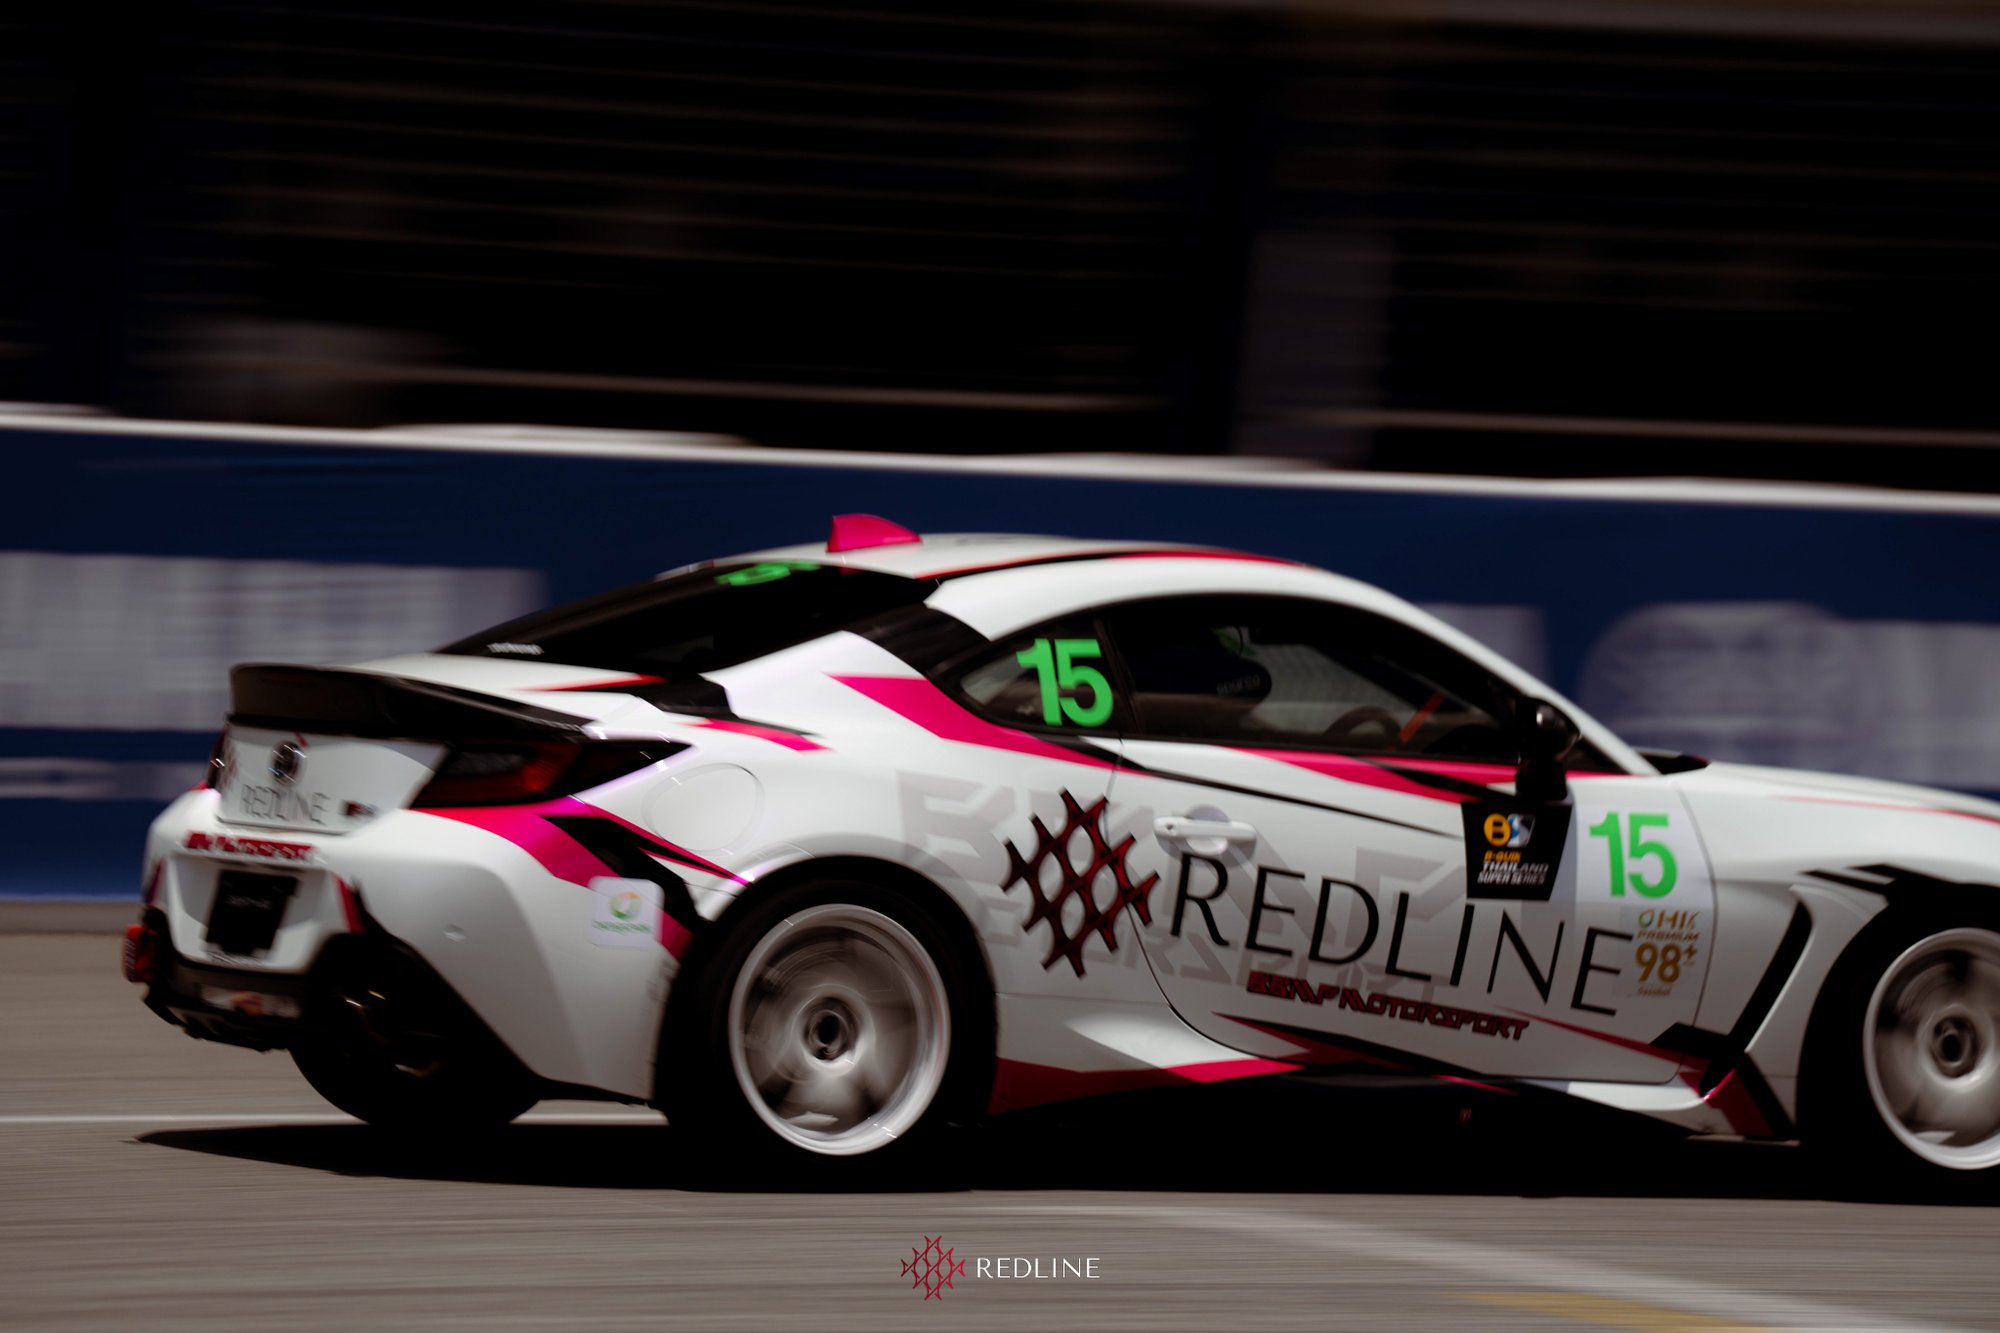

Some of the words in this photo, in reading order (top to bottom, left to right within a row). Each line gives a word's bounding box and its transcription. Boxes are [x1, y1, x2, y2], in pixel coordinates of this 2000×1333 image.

[1016, 638, 1113, 726] 15
[1477, 871, 1511, 885] SUPER
[1482, 861, 1549, 873] THAILAND
[1589, 811, 1678, 899] 15
[1170, 852, 1633, 1017] REDLINE
[1338, 987, 1530, 1040] MOTORSPORT
